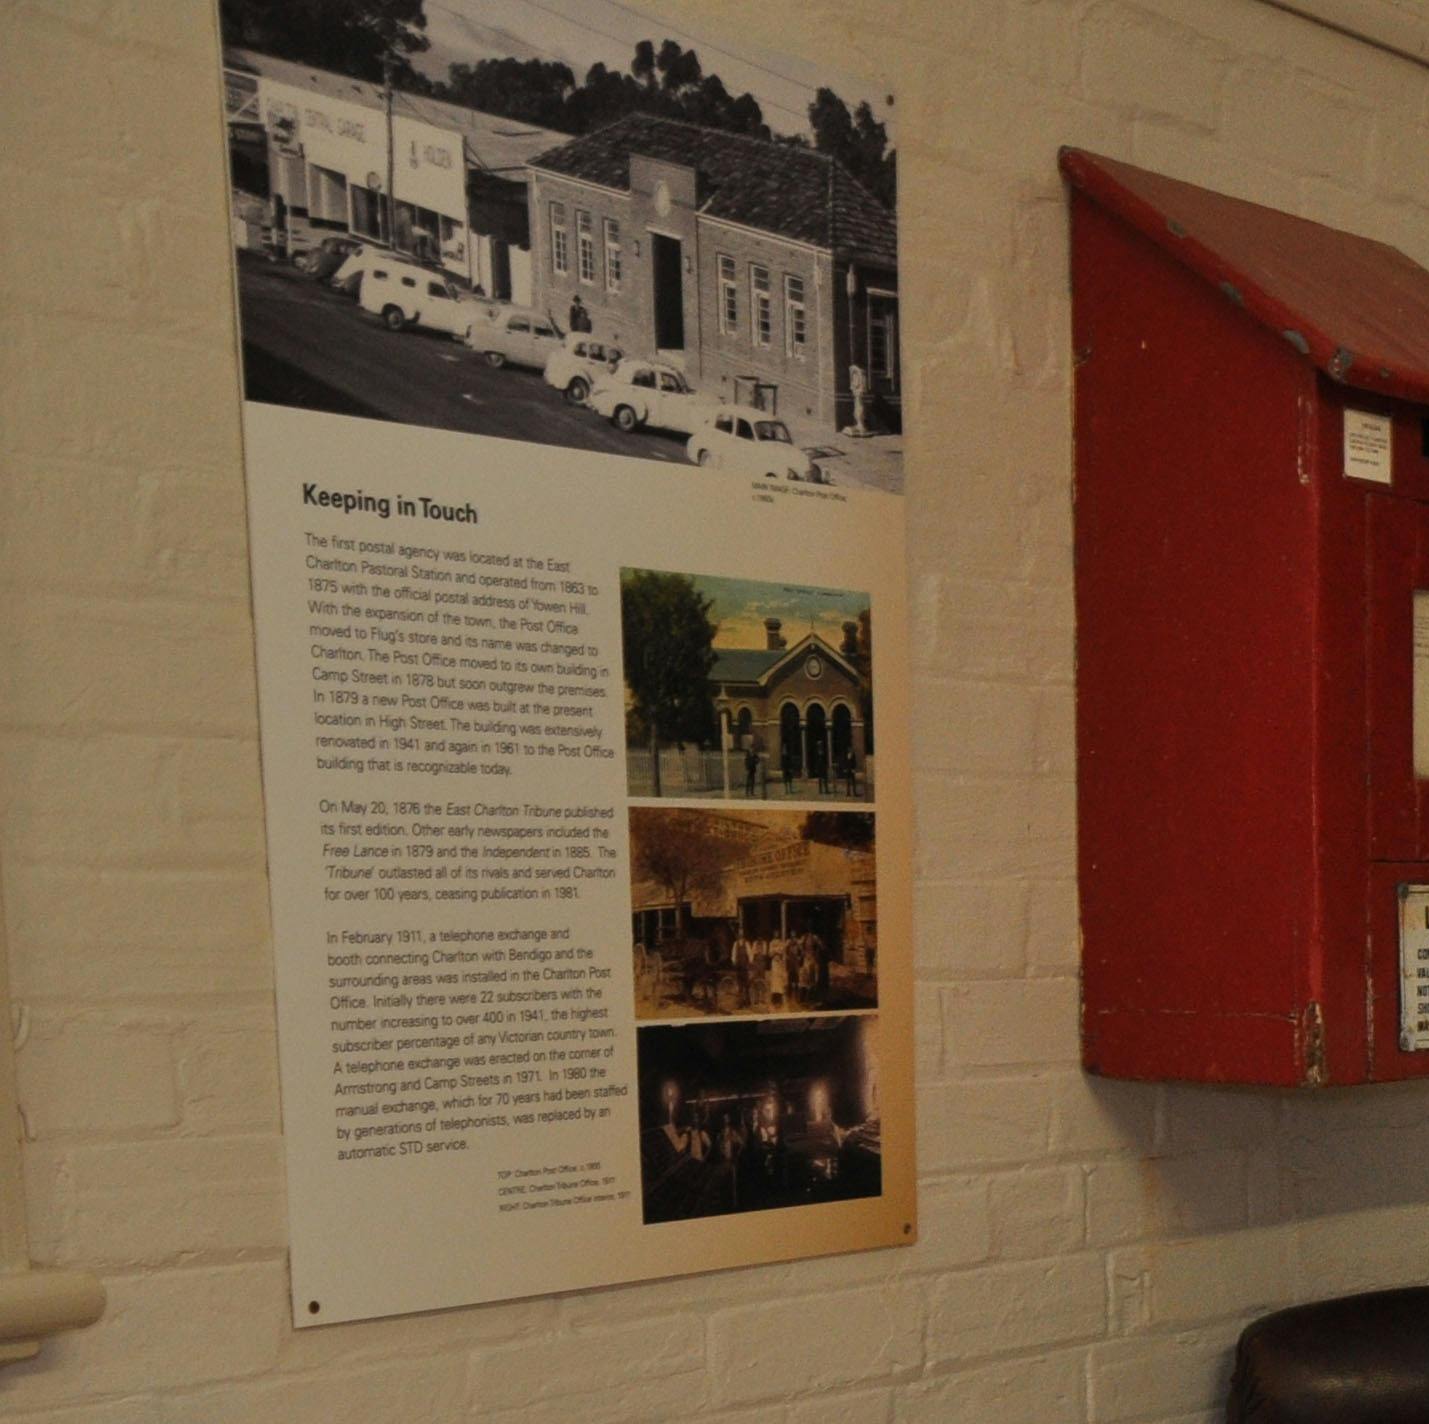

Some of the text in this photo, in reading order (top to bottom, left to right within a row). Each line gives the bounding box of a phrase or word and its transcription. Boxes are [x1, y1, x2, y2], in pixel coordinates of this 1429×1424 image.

[302, 483, 477, 523] Keeping in Touch
[304, 532, 570, 573] The first postal agency was located at the East
[306, 555, 358, 572] Charlton
[360, 561, 408, 577] Pastoral
[411, 565, 452, 581] Station
[455, 573, 476, 584] and
[479, 576, 528, 589] operated
[530, 578, 556, 591] from
[587, 585, 599, 596] to
[307, 600, 338, 615] With
[341, 604, 362, 617] the
[365, 609, 425, 621] expansion
[427, 611, 439, 623] of
[442, 613, 461, 625] the
[498, 617, 518, 629] the
[520, 618, 544, 632] Post
[546, 620, 578, 635] Office
[368, 649, 390, 663] The
[393, 650, 418, 665] Post
[422, 652, 457, 667] Office
[459, 658, 498, 670] moved
[500, 660, 512, 671] to
[514, 660, 528, 672] its
[530, 664, 554, 673] own
[556, 663, 598, 679] building
[598, 667, 610, 677] in
[314, 713, 362, 726] location
[365, 717, 376, 726] in
[379, 715, 408, 731] High
[450, 718, 471, 731] The
[472, 720, 518, 735] building
[518, 725, 542, 735] was
[544, 726, 603, 738] extensively
[316, 757, 364, 773] building
[367, 758, 391, 771] that
[394, 759, 404, 771] is
[407, 762, 478, 775] recognizable
[321, 824, 336, 835] its
[338, 822, 362, 835] first
[412, 823, 446, 836] Other
[448, 825, 475, 838] early
[478, 828, 544, 839] newspapers
[546, 826, 590, 838] included
[592, 827, 610, 839] the
[324, 887, 342, 901] for
[344, 890, 370, 900] over
[435, 889, 478, 902] ceasing
[480, 887, 539, 901] publication
[541, 887, 552, 899] in
[326, 932, 338, 944] In
[342, 931, 393, 945] February
[429, 932, 436, 942] a
[439, 930, 495, 942] telephone
[497, 929, 549, 942] exchange
[549, 928, 570, 939] and
[328, 948, 593, 966] booth connecting Charlton with Bendigo and the
[332, 1039, 394, 1053] subscriber
[396, 1037, 461, 1051] percentage
[462, 1033, 475, 1046] of
[477, 1035, 497, 1046] any
[498, 1031, 544, 1043] Victorian
[547, 1030, 586, 1041] country
[338, 1145, 396, 1160] automatic
[398, 1141, 424, 1155] STD
